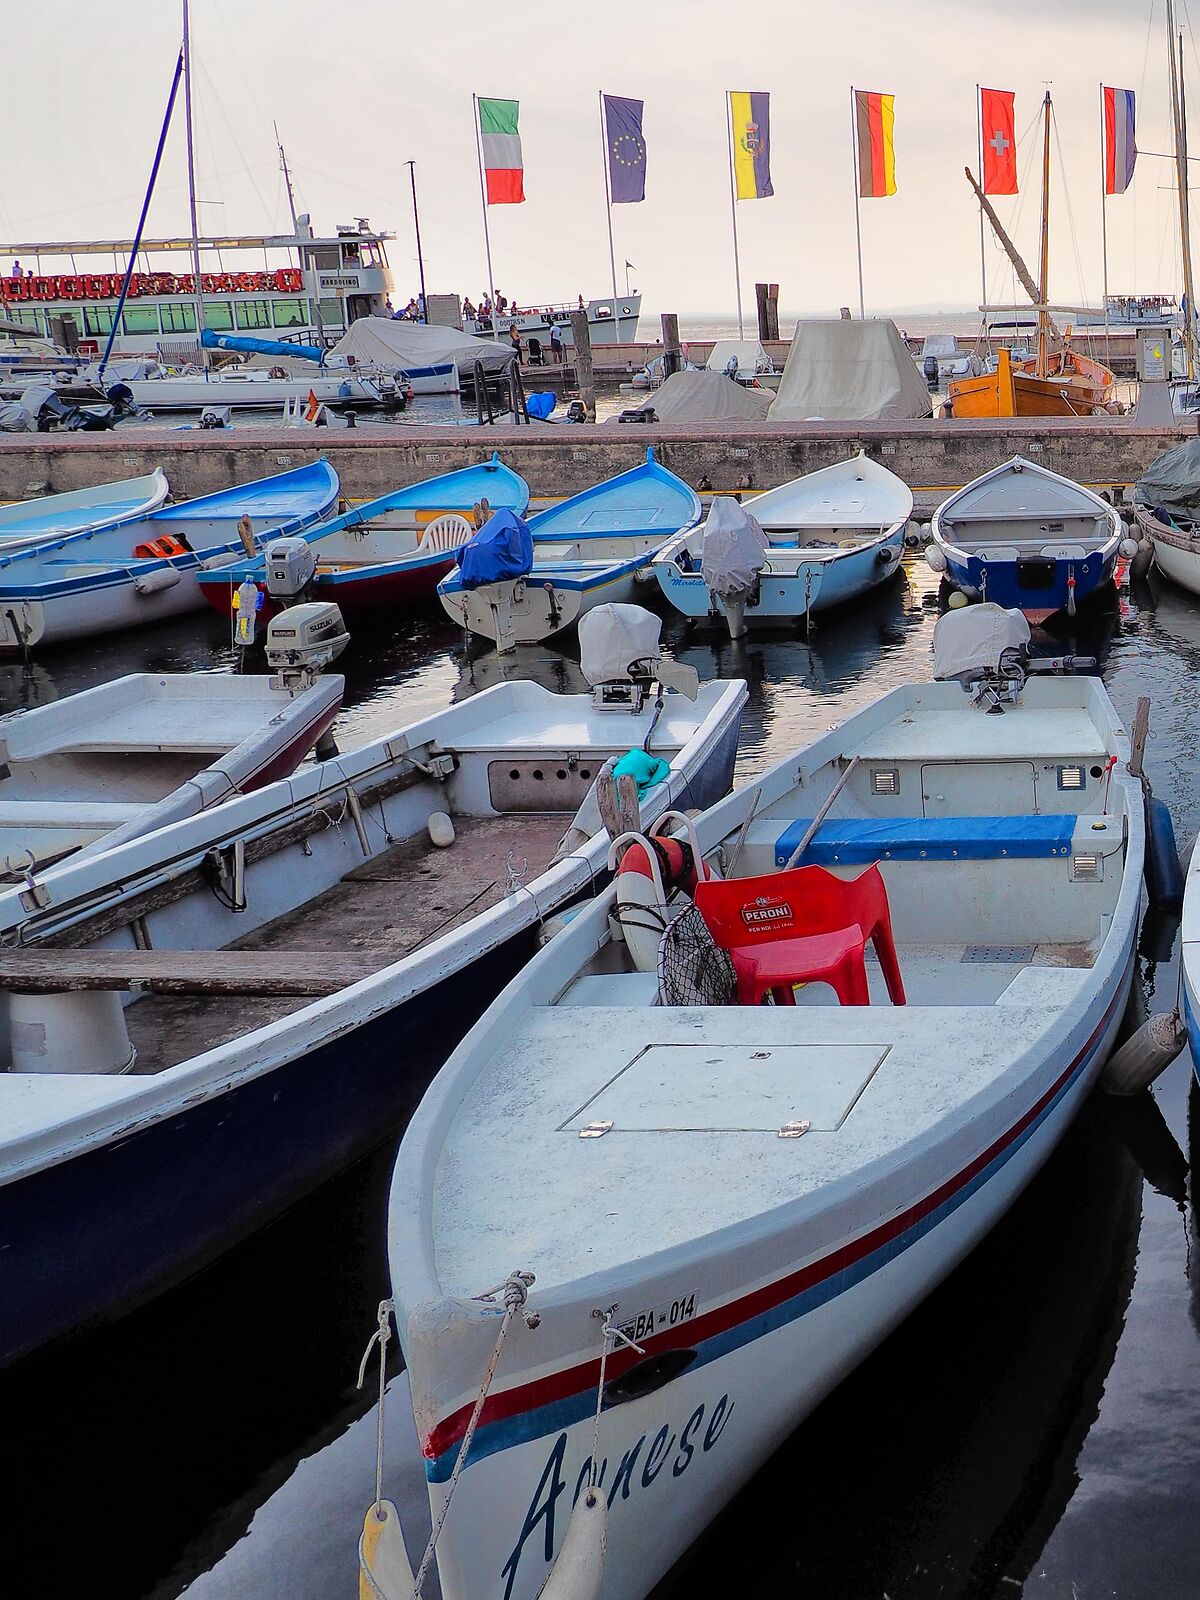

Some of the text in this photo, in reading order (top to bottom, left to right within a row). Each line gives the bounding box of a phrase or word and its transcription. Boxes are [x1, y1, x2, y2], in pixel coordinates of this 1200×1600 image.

[542, 313, 571, 322] VERO
[309, 619, 333, 633] SUZUKI
[745, 907, 788, 920] PERONI
[635, 1311, 654, 1339] BA
[669, 1294, 695, 1325] 014
